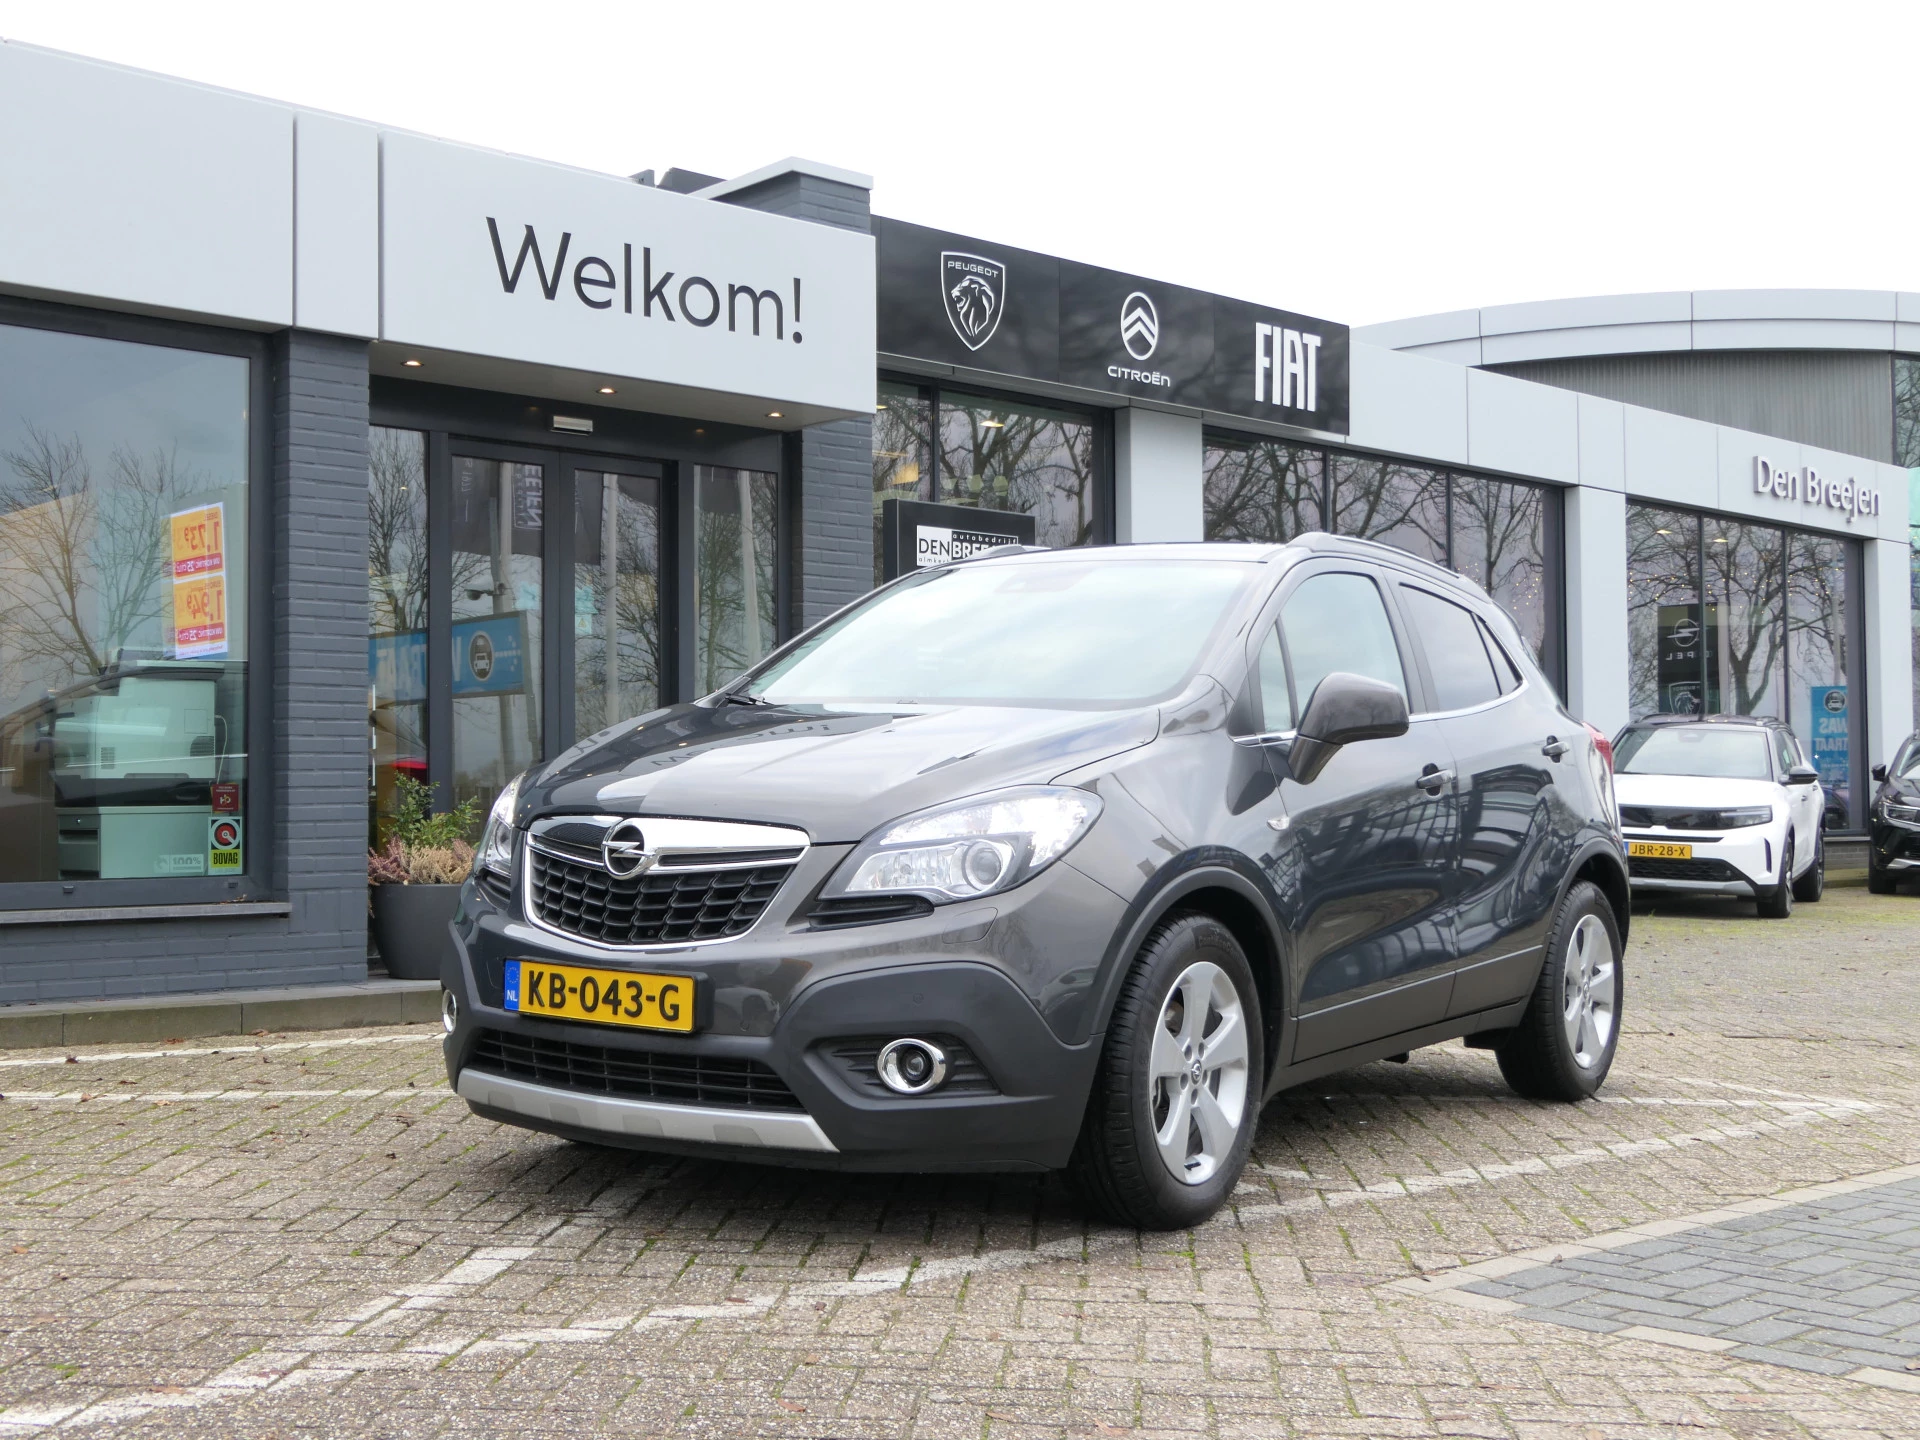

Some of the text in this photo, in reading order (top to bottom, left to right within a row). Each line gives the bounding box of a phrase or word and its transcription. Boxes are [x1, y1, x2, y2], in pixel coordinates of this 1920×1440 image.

[947, 261, 999, 278] PEUGEOT
[486, 216, 803, 344] Welkom!
[1255, 321, 1322, 412] FIAT
[1753, 455, 1881, 524] Den Breejen
[919, 538, 950, 557] DEN
[213, 852, 238, 865] BOVAG
[1631, 844, 1686, 857] JBR-28-X
[506, 989, 518, 1002] NL
[527, 969, 680, 1022] KB-043-G
